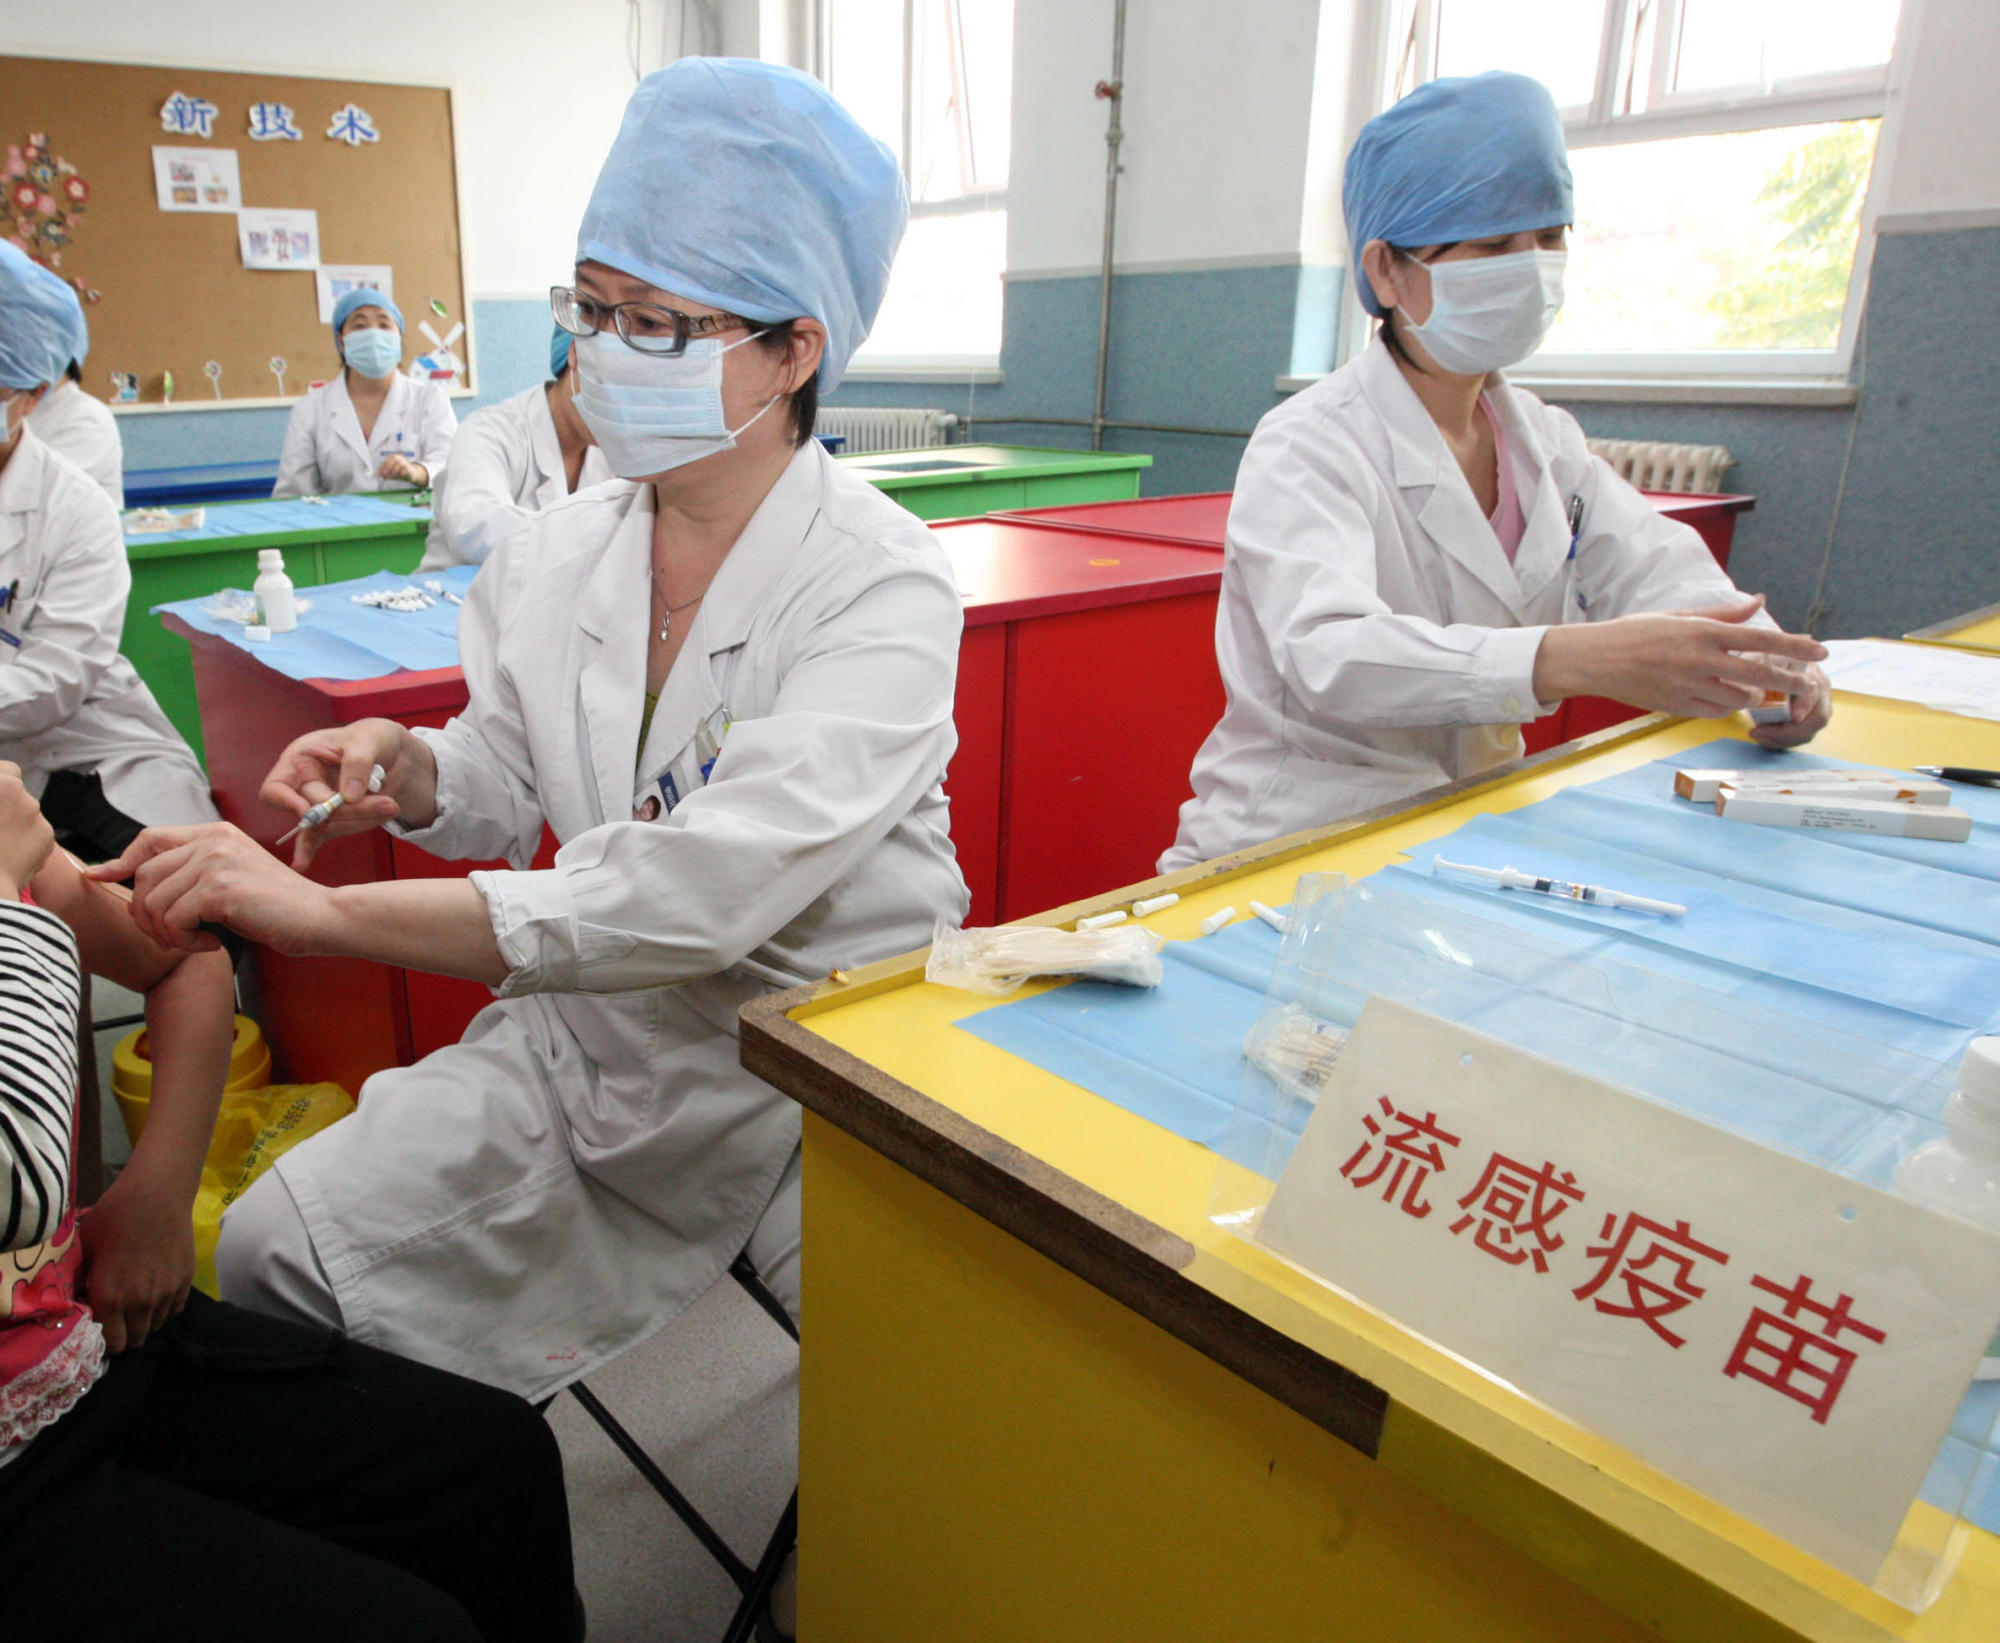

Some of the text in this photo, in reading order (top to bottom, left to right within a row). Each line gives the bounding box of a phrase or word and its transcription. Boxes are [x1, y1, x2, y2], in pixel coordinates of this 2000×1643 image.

[166, 94, 376, 141] 新技术
[1339, 1095, 1887, 1425] 流感疫苗
